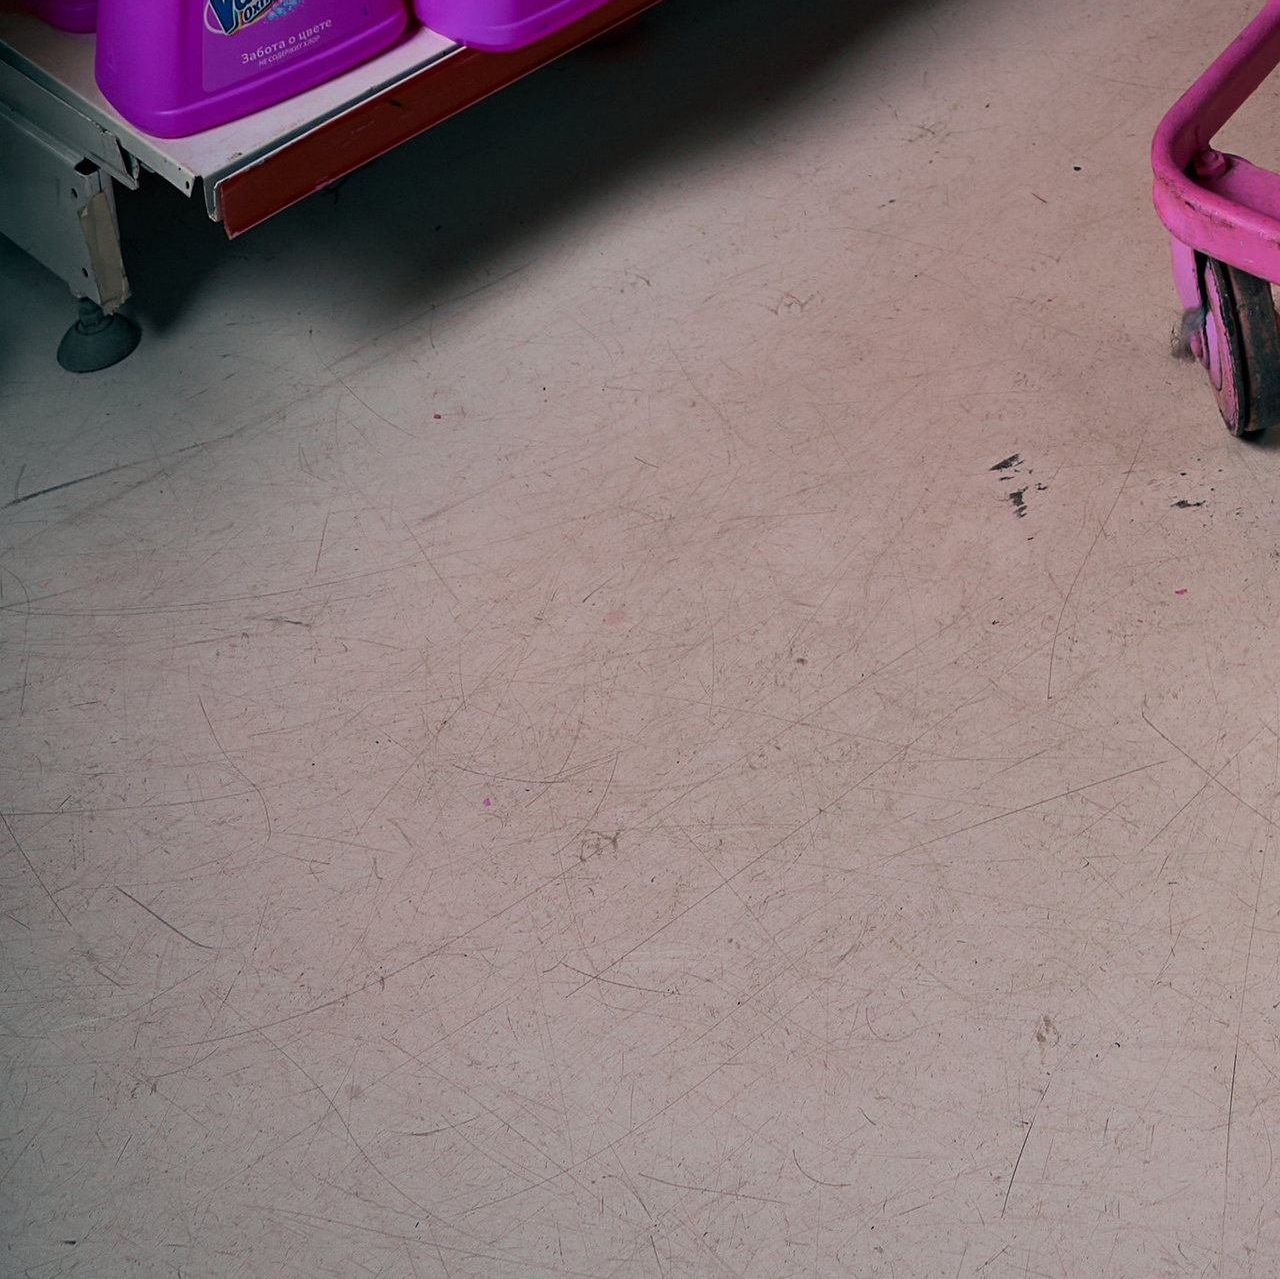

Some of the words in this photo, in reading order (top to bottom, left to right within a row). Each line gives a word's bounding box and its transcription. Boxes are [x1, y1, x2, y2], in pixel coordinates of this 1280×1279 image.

[243, 0, 265, 23] Oxi
[241, 41, 287, 64] Забота
[298, 18, 332, 40] цвете
